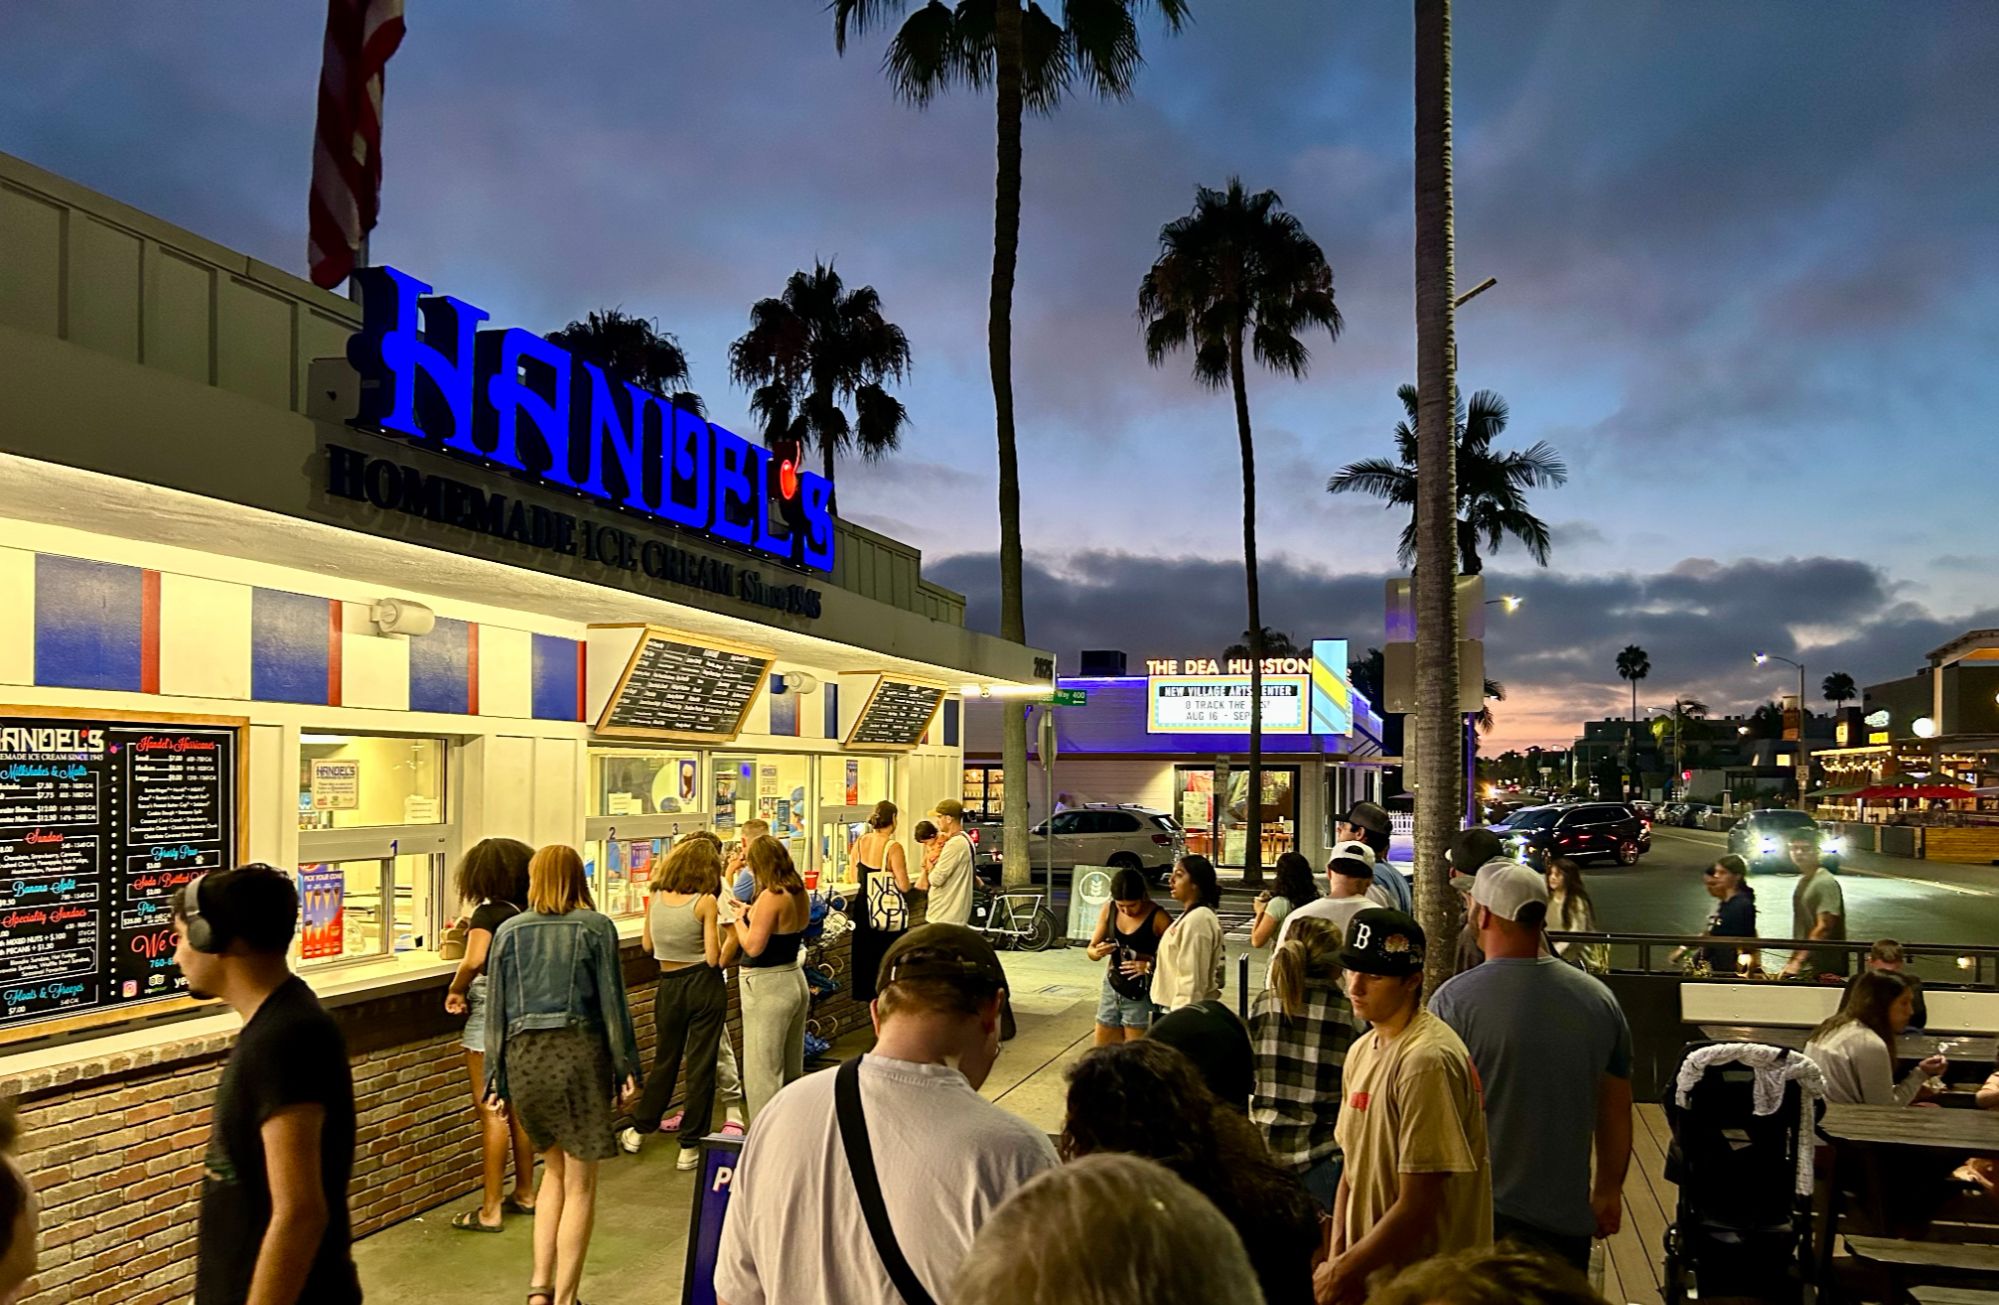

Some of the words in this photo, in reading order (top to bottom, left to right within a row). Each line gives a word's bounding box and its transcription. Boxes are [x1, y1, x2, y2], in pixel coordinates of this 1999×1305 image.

[326, 443, 578, 556] HOMEMADE
[580, 520, 637, 571] ICE
[642, 540, 735, 597] CREAM
[740, 569, 788, 611] Since
[1146, 660, 1177, 675] THE
[1185, 659, 1219, 675] DEA
[1072, 691, 1086, 699] 400
[1165, 687, 1184, 697] NEW
[1188, 686, 1226, 697] VILLAGE
[1230, 686, 1252, 697] ARTS
[1261, 686, 1292, 696] ENTER
[1196, 701, 1225, 709] TRACK
[1229, 701, 1245, 709] THE
[1186, 712, 1203, 720] AUG
[1209, 712, 1218, 720] 16
[0, 727, 104, 753] ANDEL'S
[41, 753, 67, 761] CREAM
[68, 753, 89, 761] SINCE
[51, 765, 60, 777] &
[609, 827, 616, 840] 2
[672, 823, 679, 835] 3
[390, 840, 398, 856] 1
[12, 881, 48, 897] Banana
[49, 878, 76, 894] Split
[1353, 923, 1371, 949] B
[131, 930, 169, 958] We
[712, 1166, 732, 1192] P
